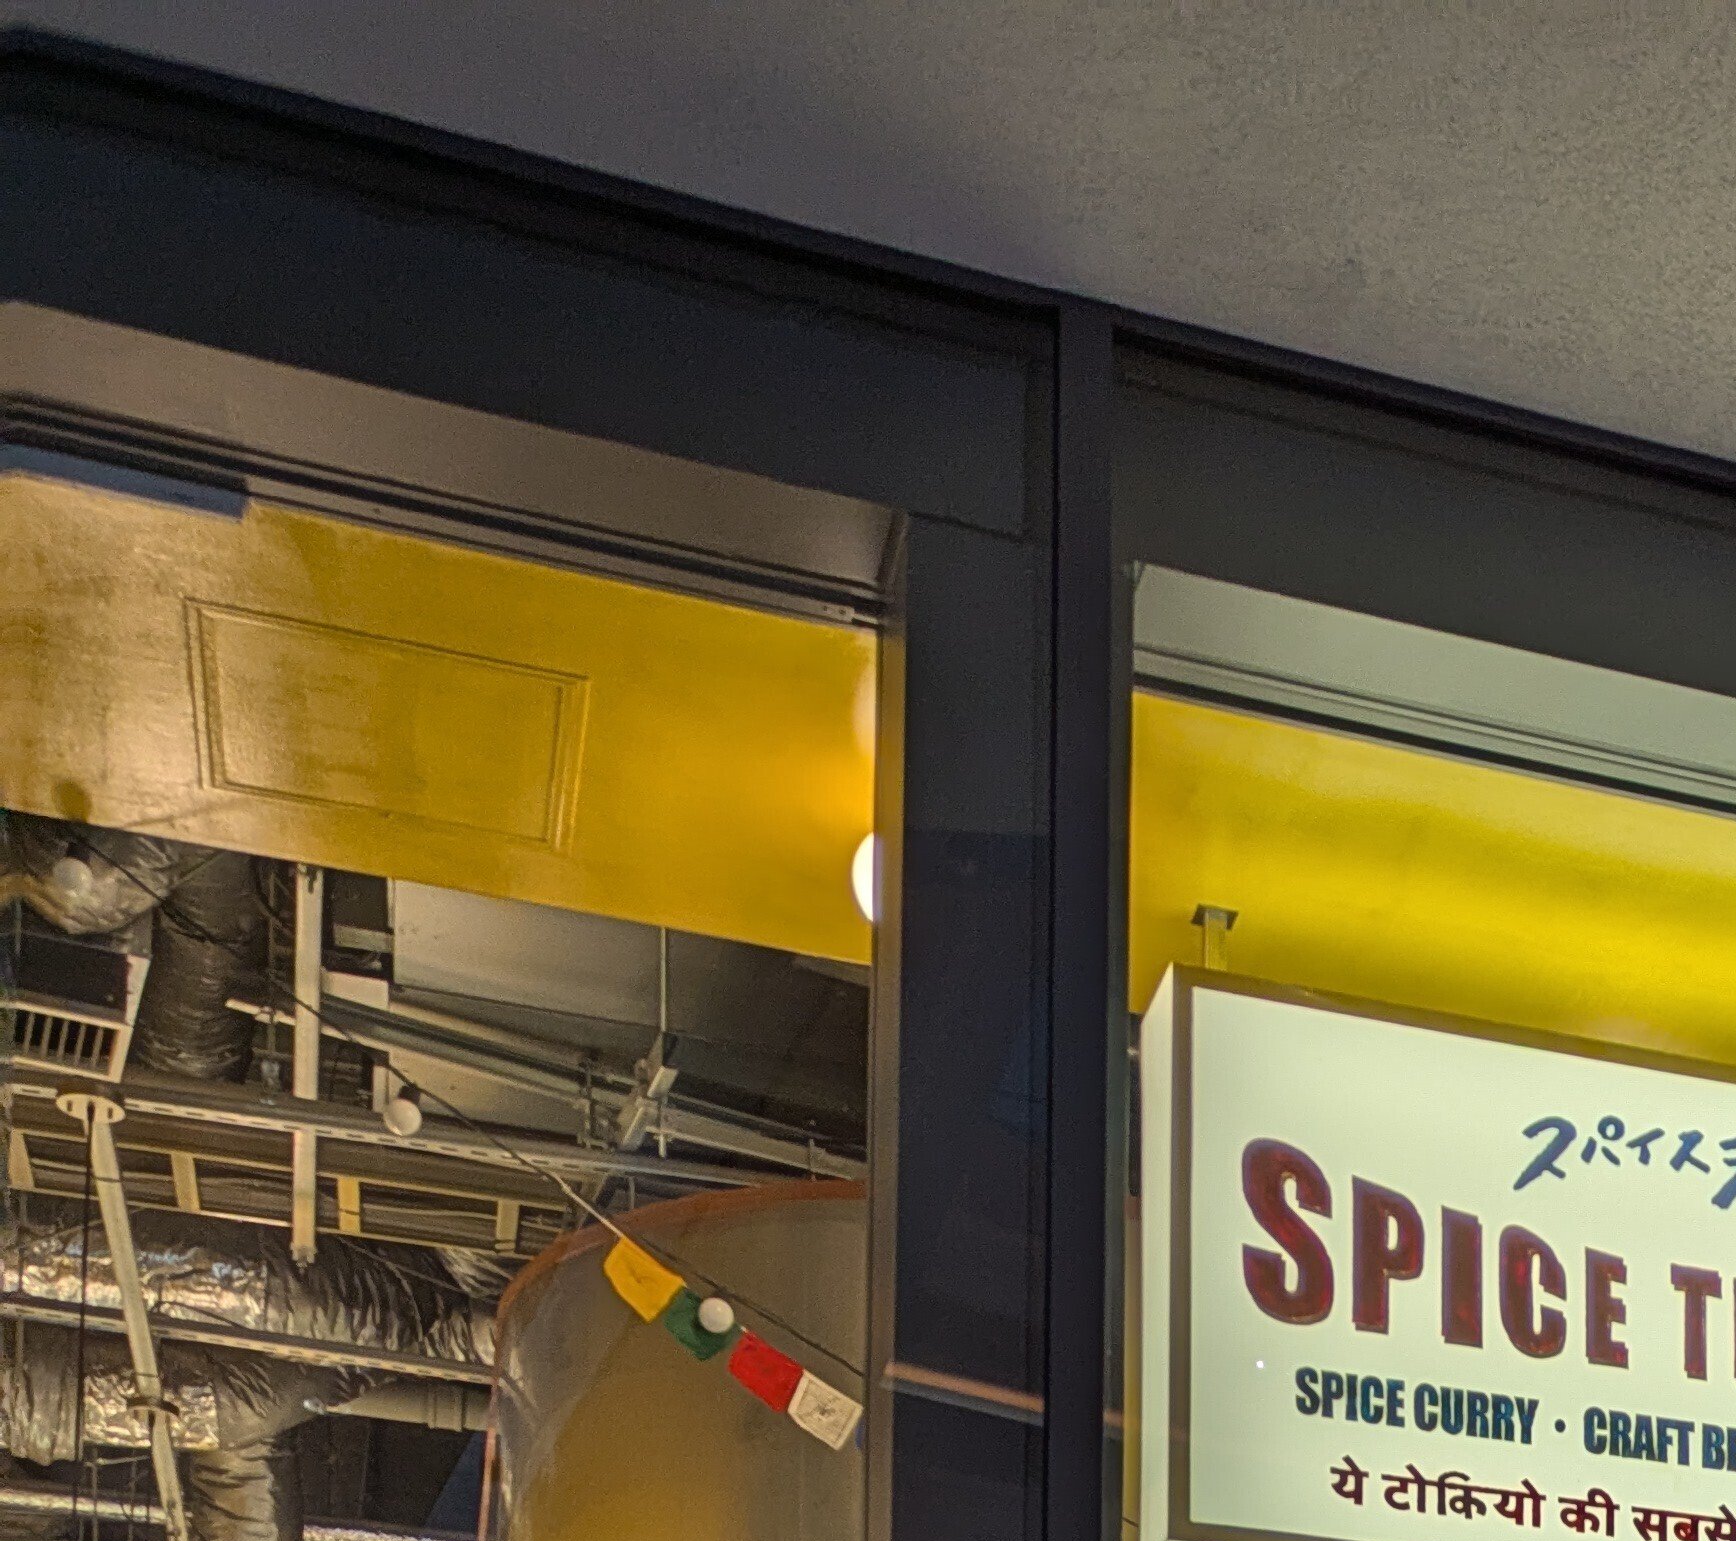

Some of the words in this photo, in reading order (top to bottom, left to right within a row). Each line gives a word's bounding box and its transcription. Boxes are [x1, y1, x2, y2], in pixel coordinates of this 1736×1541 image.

[1241, 1136, 1630, 1370] SPICE
[1295, 1366, 1407, 1428] SPICE
[1414, 1381, 1539, 1444] CURRY
[1582, 1406, 1695, 1467] CRAFT
[1330, 1457, 1370, 1512] ये
[1381, 1465, 1547, 1530] टोकियो
[1558, 1486, 1621, 1539] की
